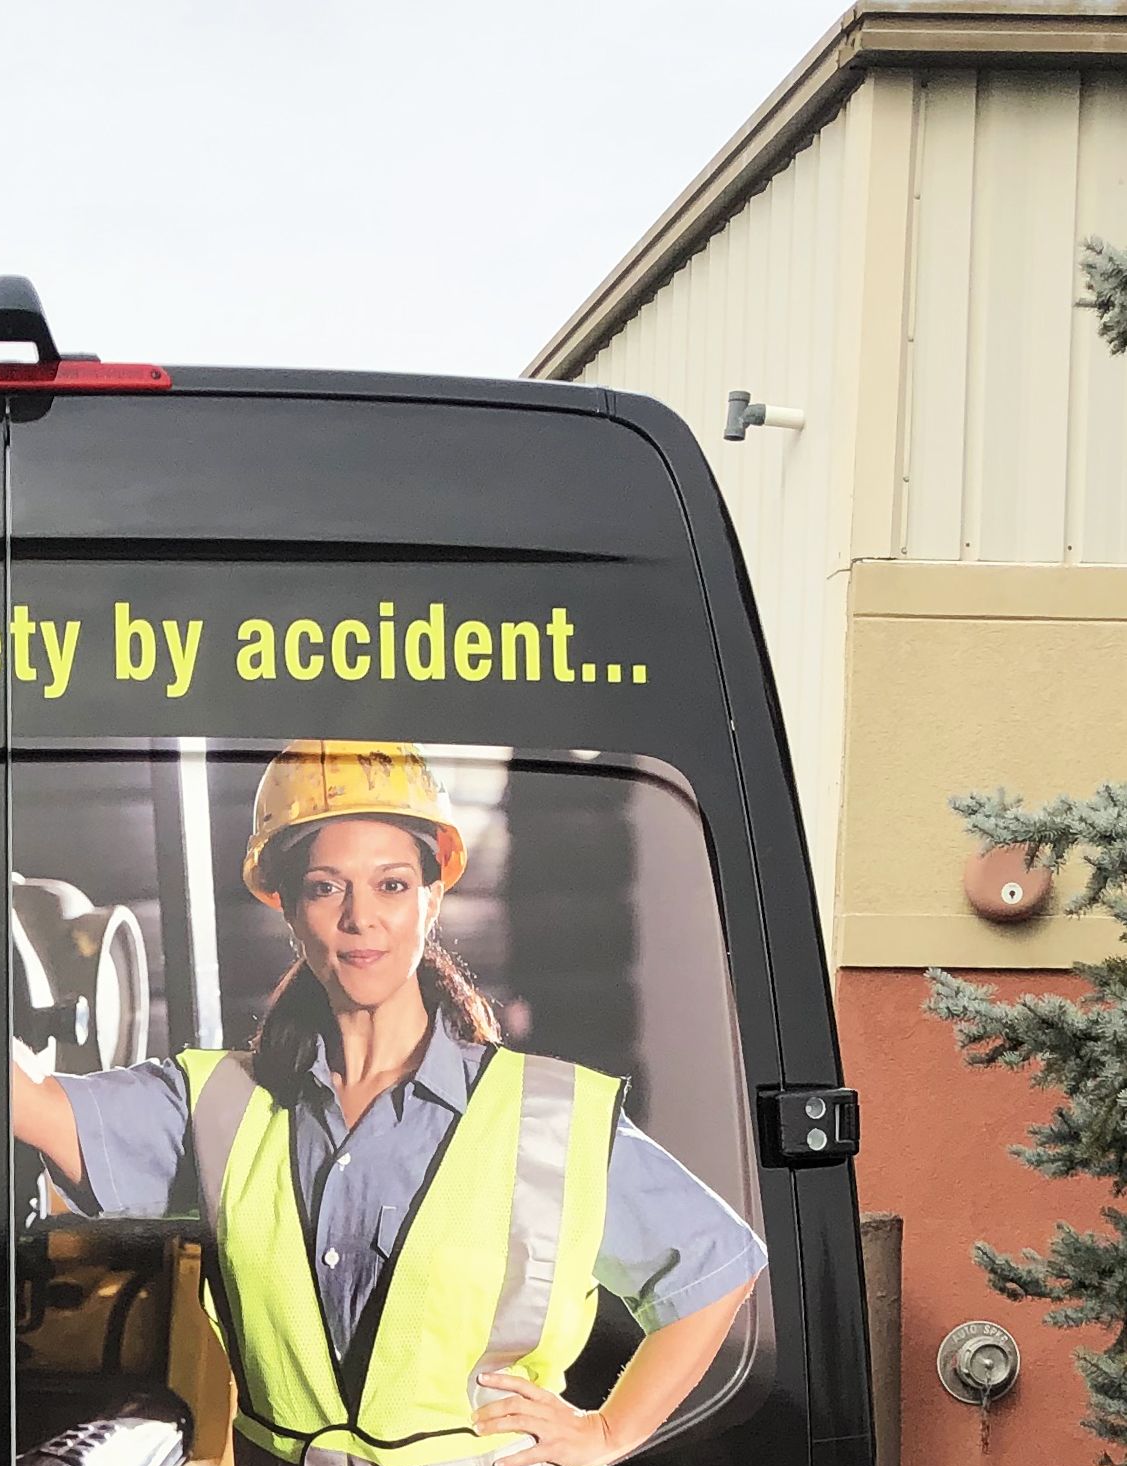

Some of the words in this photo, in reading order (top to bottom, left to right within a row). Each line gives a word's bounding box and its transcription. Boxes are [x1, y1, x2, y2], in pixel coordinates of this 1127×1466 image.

[115, 602, 203, 697] by
[237, 601, 646, 683] accident...
[952, 1325, 977, 1343] AUTO
